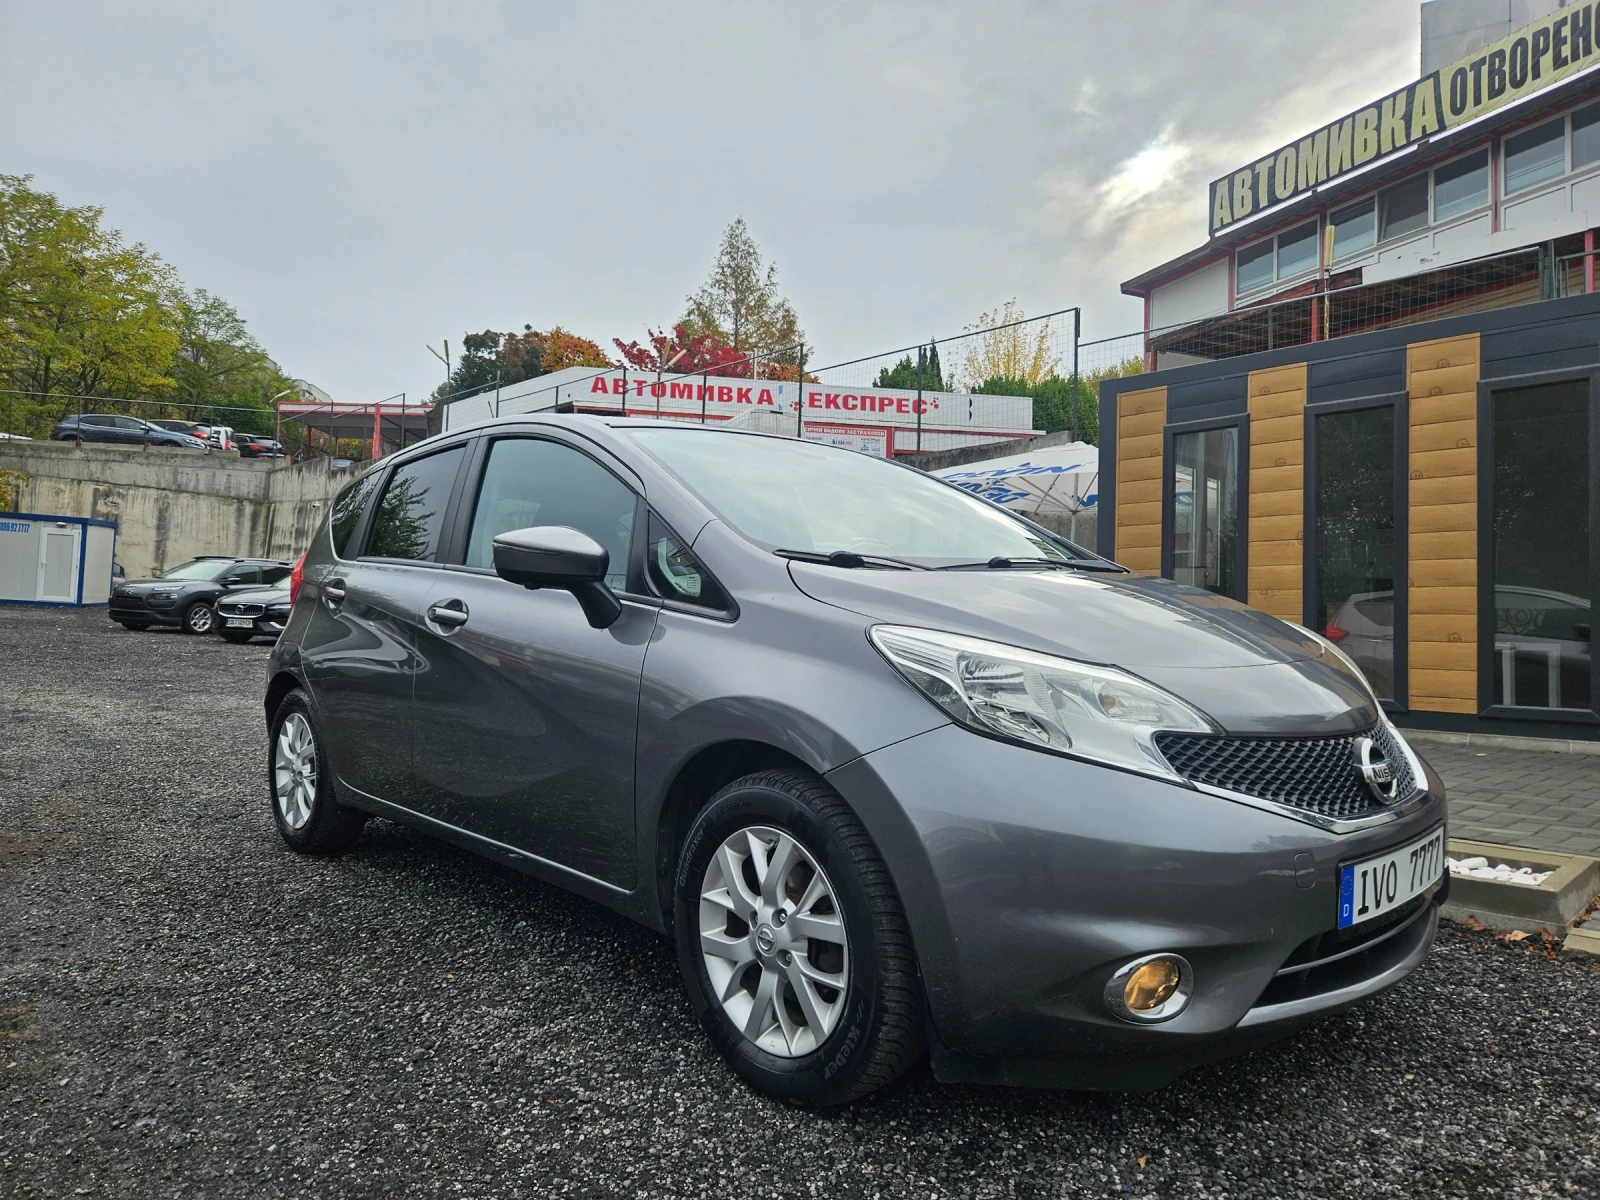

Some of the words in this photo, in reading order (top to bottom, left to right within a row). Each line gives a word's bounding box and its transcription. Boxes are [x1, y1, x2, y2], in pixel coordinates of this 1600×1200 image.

[1213, 78, 1439, 230] АВТОМИВКА
[590, 377, 774, 405] АВТОМИВКА
[808, 392, 928, 415] ЕКСПРЕС
[679, 829, 704, 887] Quadraxer
[1343, 903, 1350, 917] D
[1358, 860, 1397, 916] IVO
[1410, 834, 1441, 893] 7777
[823, 1024, 861, 1081] Kleber
